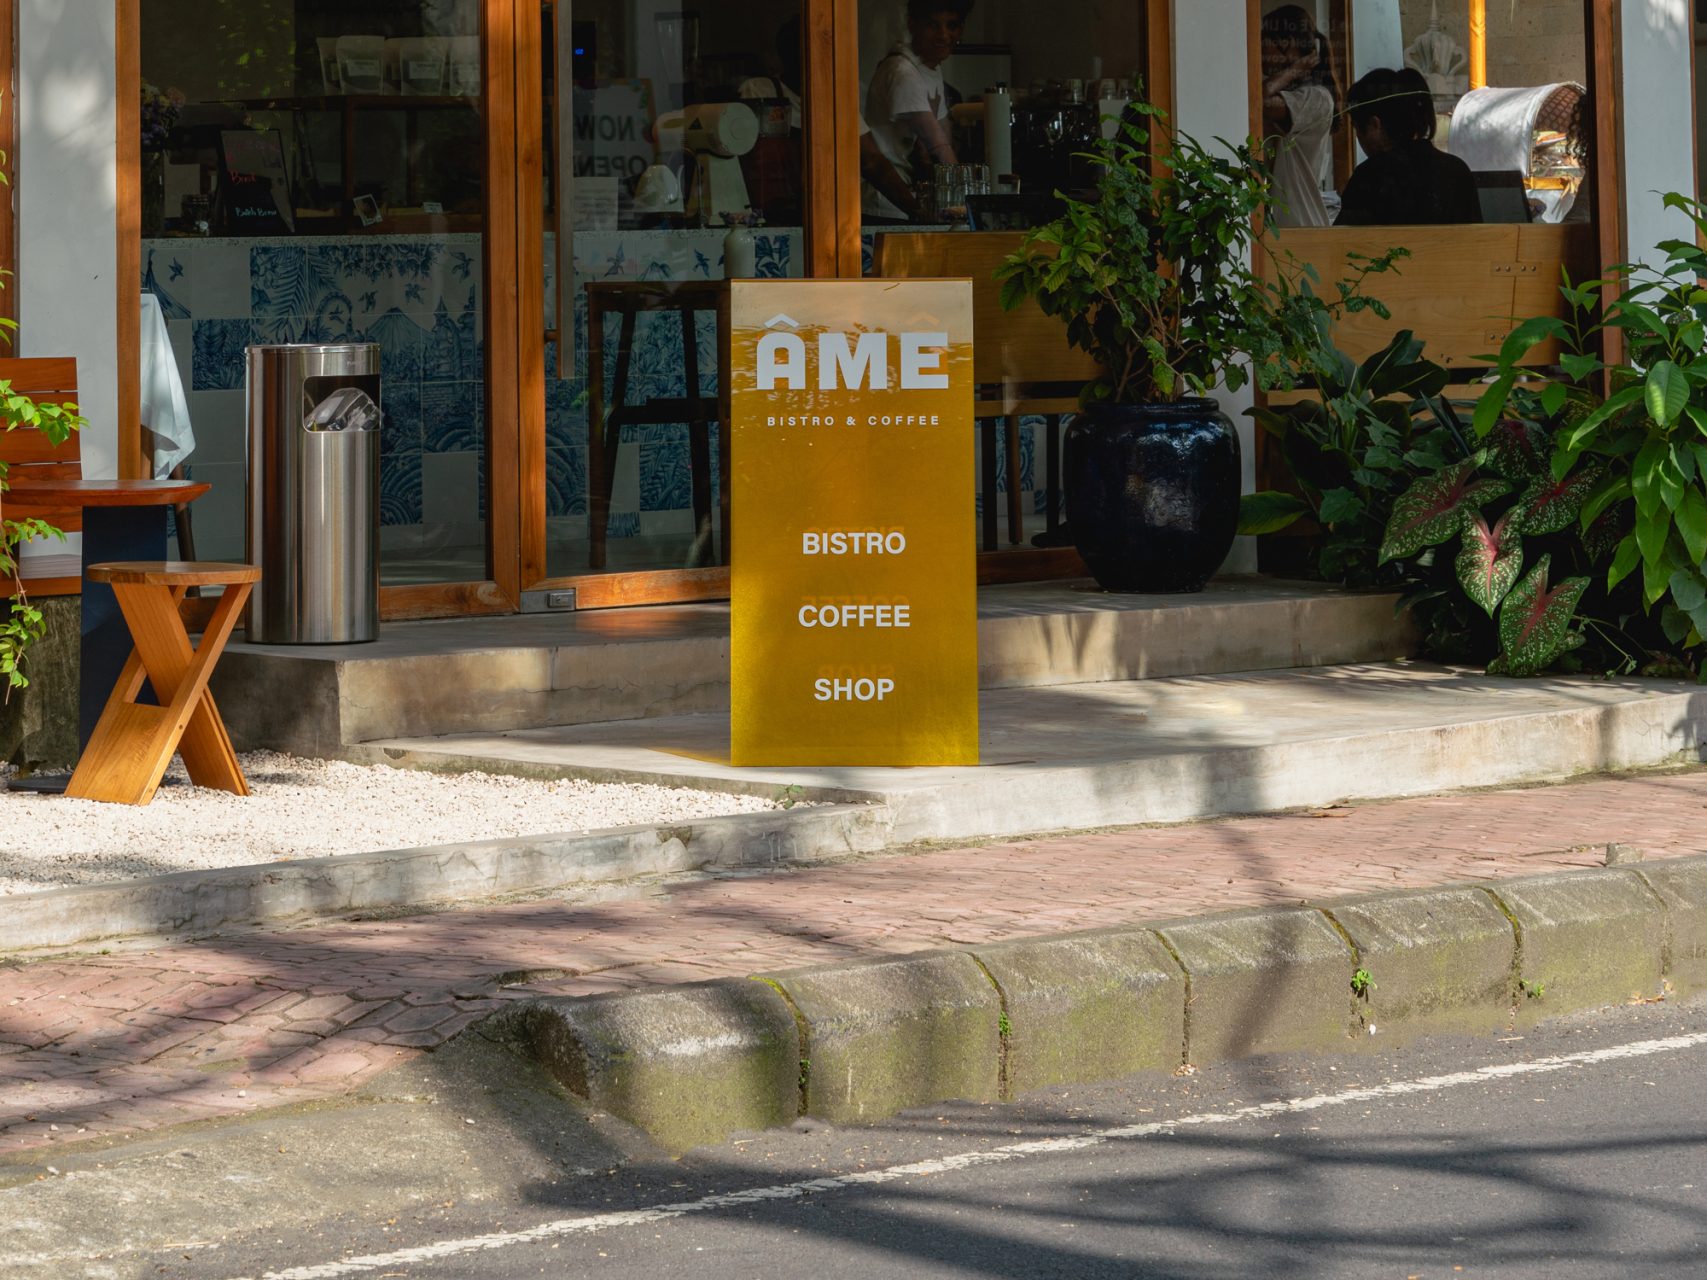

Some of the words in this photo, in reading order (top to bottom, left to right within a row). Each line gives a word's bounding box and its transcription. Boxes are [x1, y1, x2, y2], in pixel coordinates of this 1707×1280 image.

[756, 313, 949, 390] ÂME
[767, 416, 835, 426] BISTRO
[846, 416, 856, 426] &
[868, 415, 939, 426] COFFEE
[802, 532, 906, 555] BISTRO
[798, 605, 910, 628] COFFEE
[814, 678, 895, 701] SHOP
